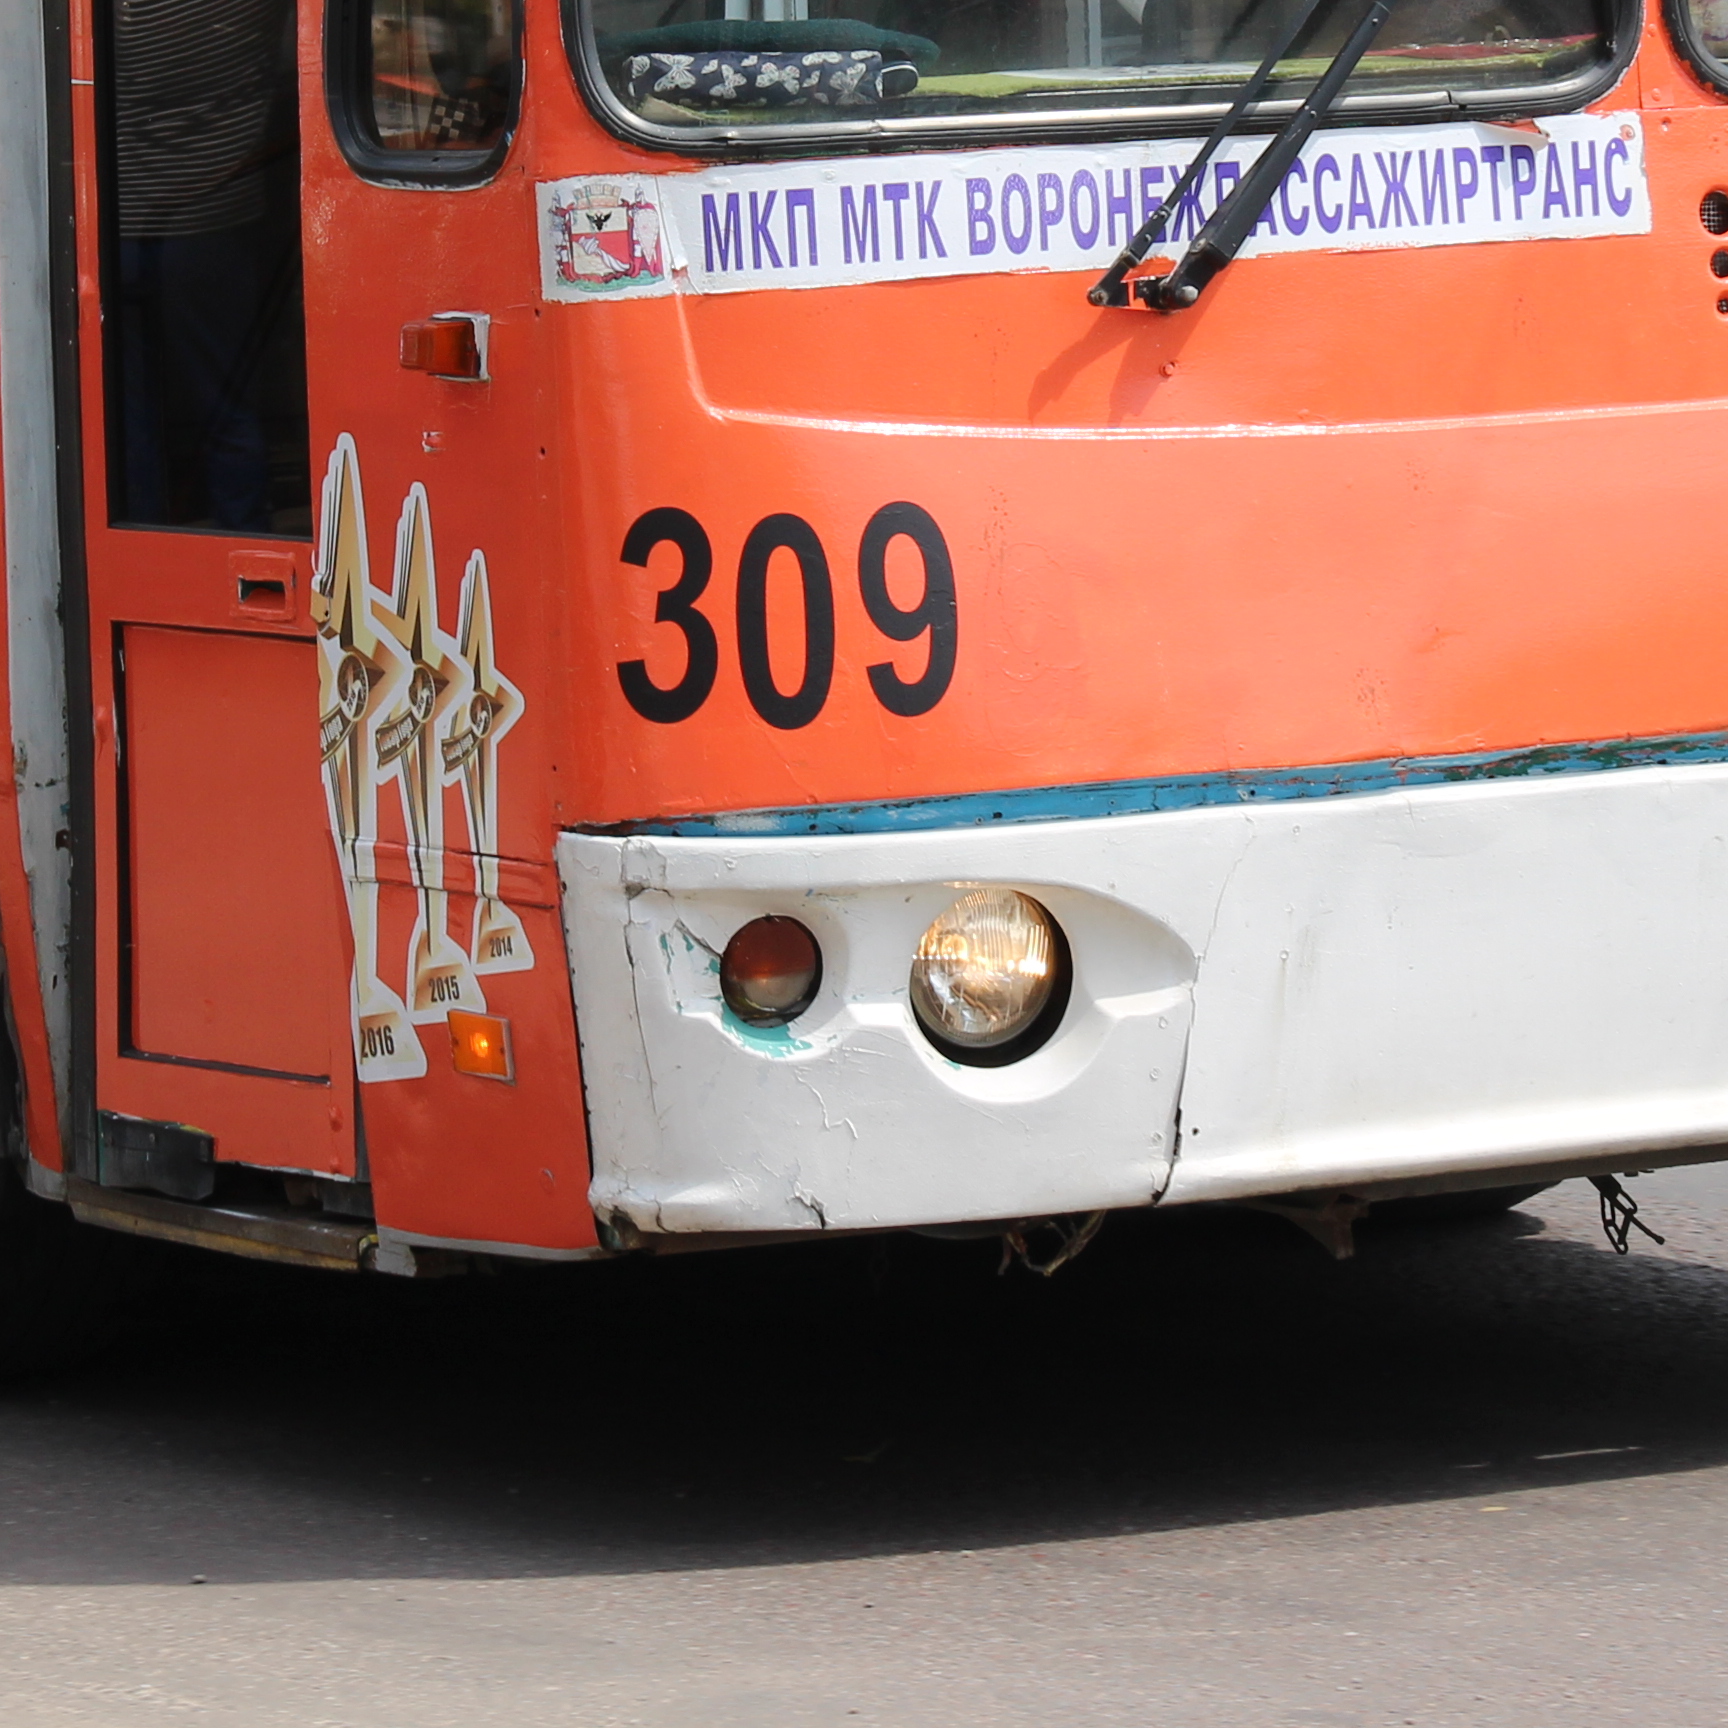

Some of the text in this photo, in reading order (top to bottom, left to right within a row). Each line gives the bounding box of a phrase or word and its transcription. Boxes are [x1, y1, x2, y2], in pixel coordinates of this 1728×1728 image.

[701, 186, 819, 273] МКП
[840, 179, 949, 265] МТК
[616, 501, 959, 730] 309
[489, 935, 513, 958] 2014
[429, 975, 460, 1003] 2015
[360, 1024, 394, 1059] 2016
